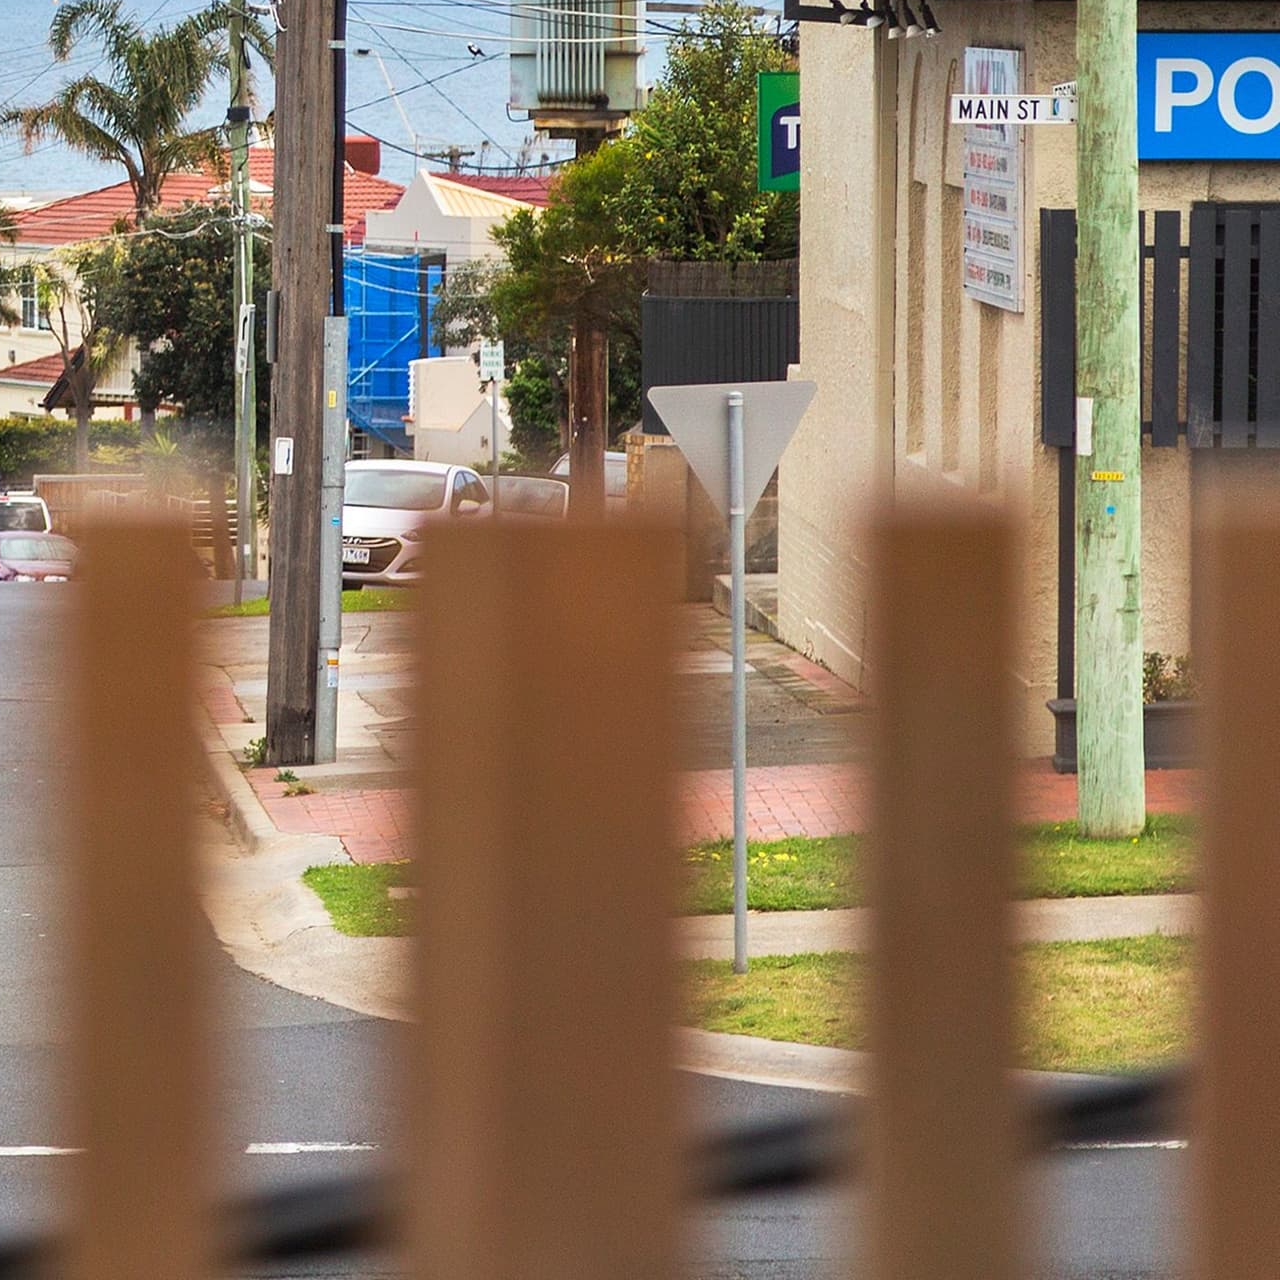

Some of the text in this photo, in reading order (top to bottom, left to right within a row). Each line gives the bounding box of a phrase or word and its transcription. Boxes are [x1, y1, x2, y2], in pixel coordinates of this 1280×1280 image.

[959, 99, 1040, 120] MAIN ST
[1154, 56, 1280, 134] PO
[780, 115, 800, 149] T
